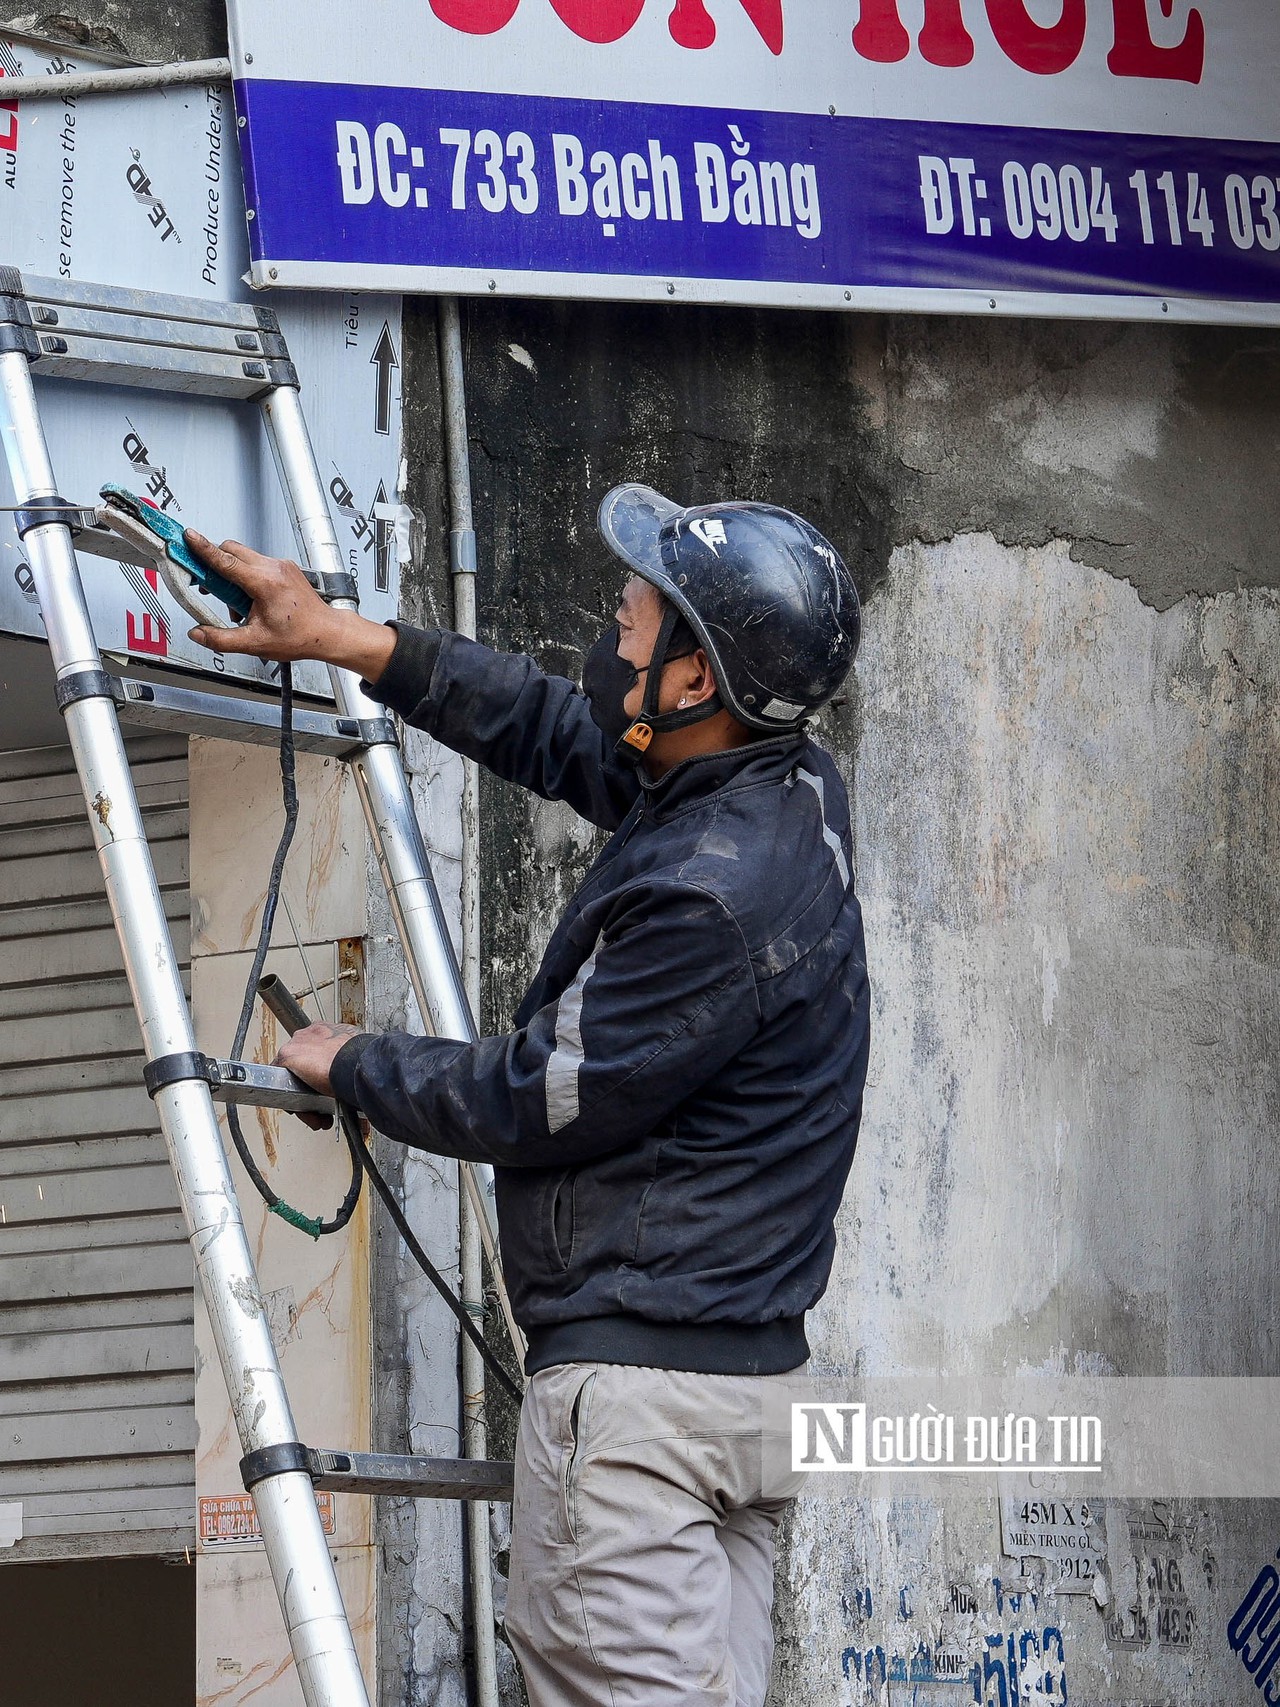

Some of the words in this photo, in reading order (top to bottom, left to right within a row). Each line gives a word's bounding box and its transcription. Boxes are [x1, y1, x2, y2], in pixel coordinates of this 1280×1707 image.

[60, 113, 76, 152] the
[205, 113, 221, 181] Under
[59, 158, 75, 246] remove
[126, 162, 175, 243] LEAD
[336, 120, 428, 208] ĐC:
[439, 128, 539, 215] 733
[552, 133, 684, 237] Bạch
[693, 124, 822, 239] Đằng
[918, 155, 991, 237] ĐT:
[1002, 161, 1118, 242] 0904
[1128, 169, 1214, 247] 114
[1224, 173, 1280, 251] 03
[202, 190, 220, 285] Produce
[344, 304, 360, 350] Tiêu
[1020, 1501, 1057, 1525] 45M
[1062, 1503, 1076, 1526] X
[1038, 1534, 1076, 1549] TRUNG
